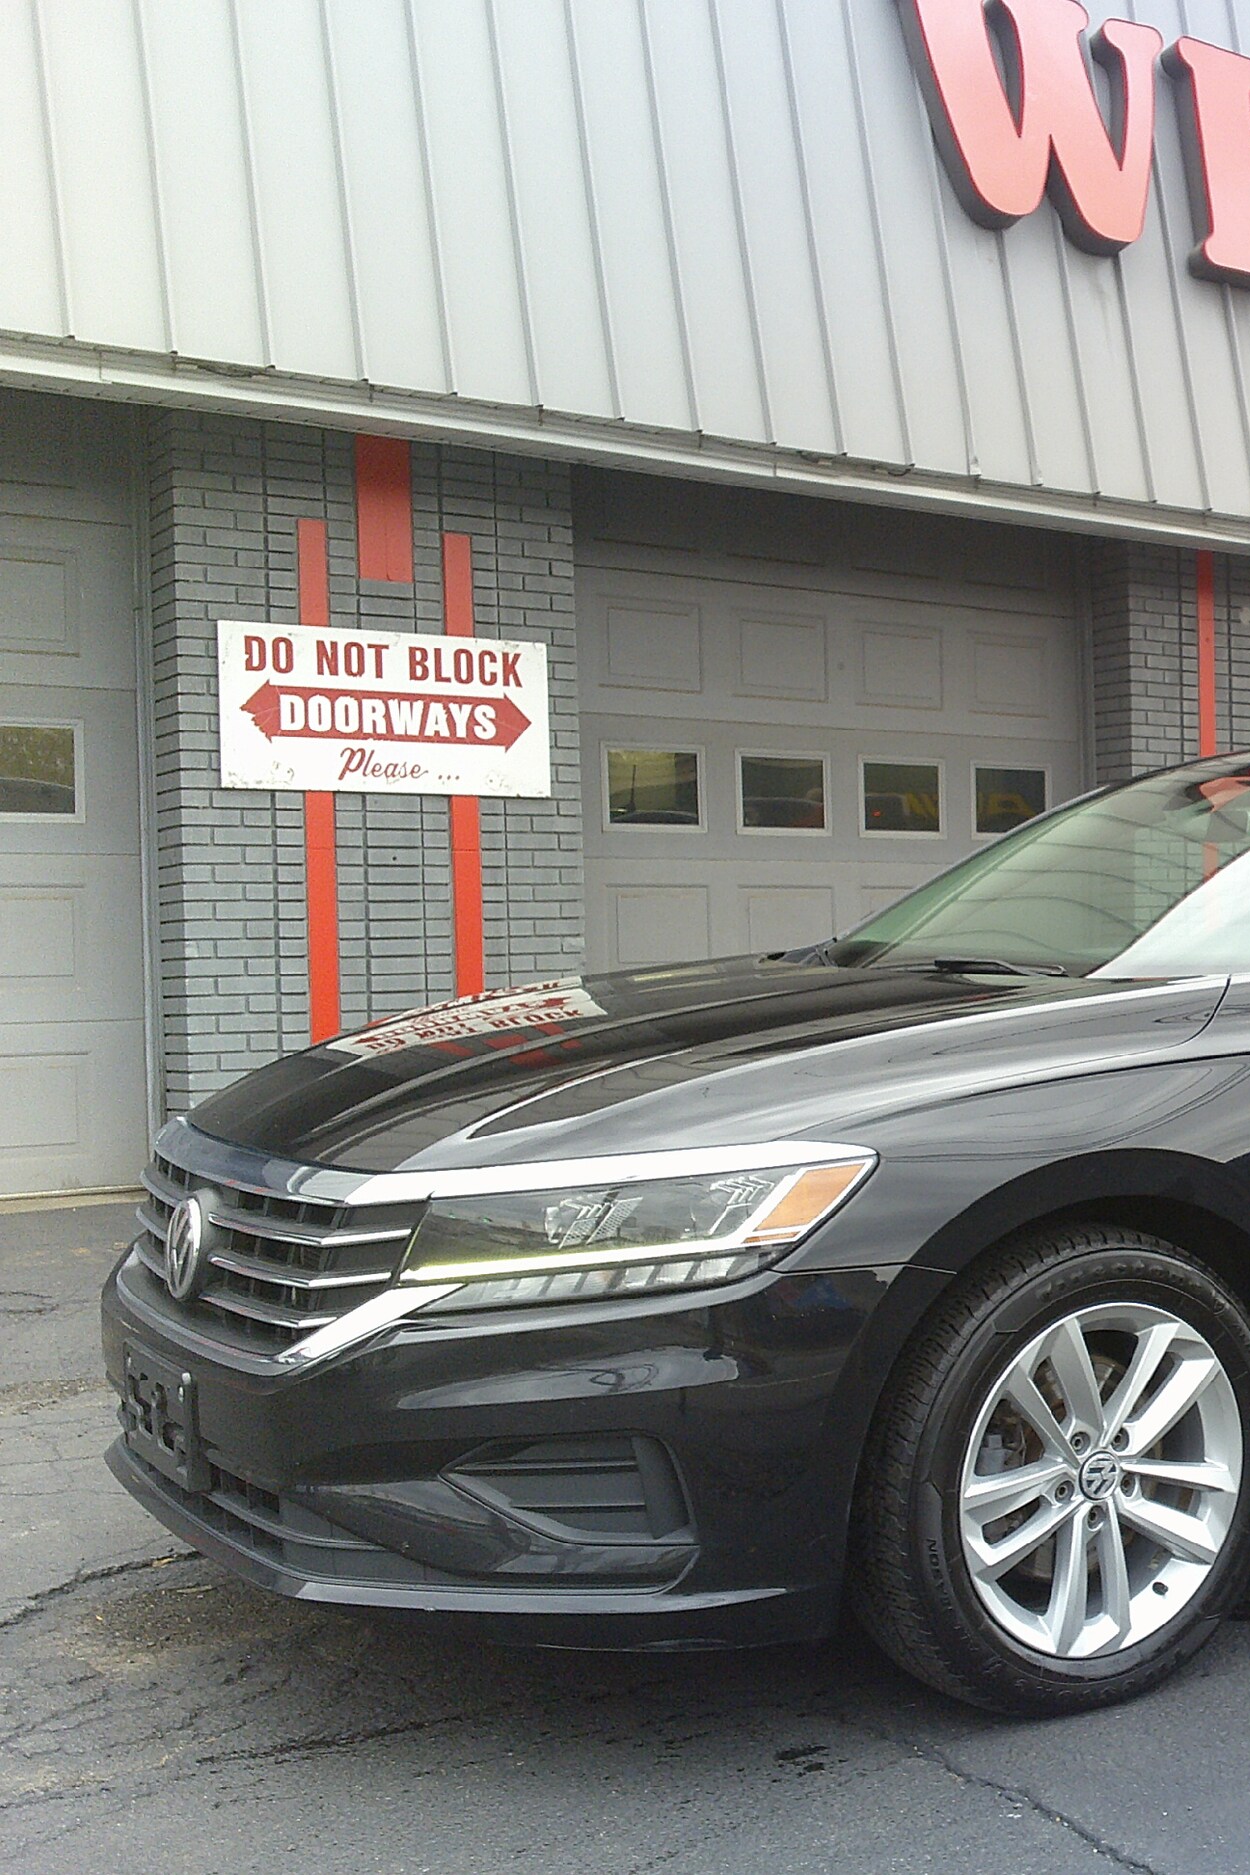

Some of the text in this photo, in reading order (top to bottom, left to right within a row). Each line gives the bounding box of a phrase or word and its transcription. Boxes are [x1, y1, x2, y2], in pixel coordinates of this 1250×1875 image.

[244, 635, 523, 688] DO NOT BLOCK
[279, 693, 497, 740] DOORWAYS
[338, 747, 429, 781] Please
